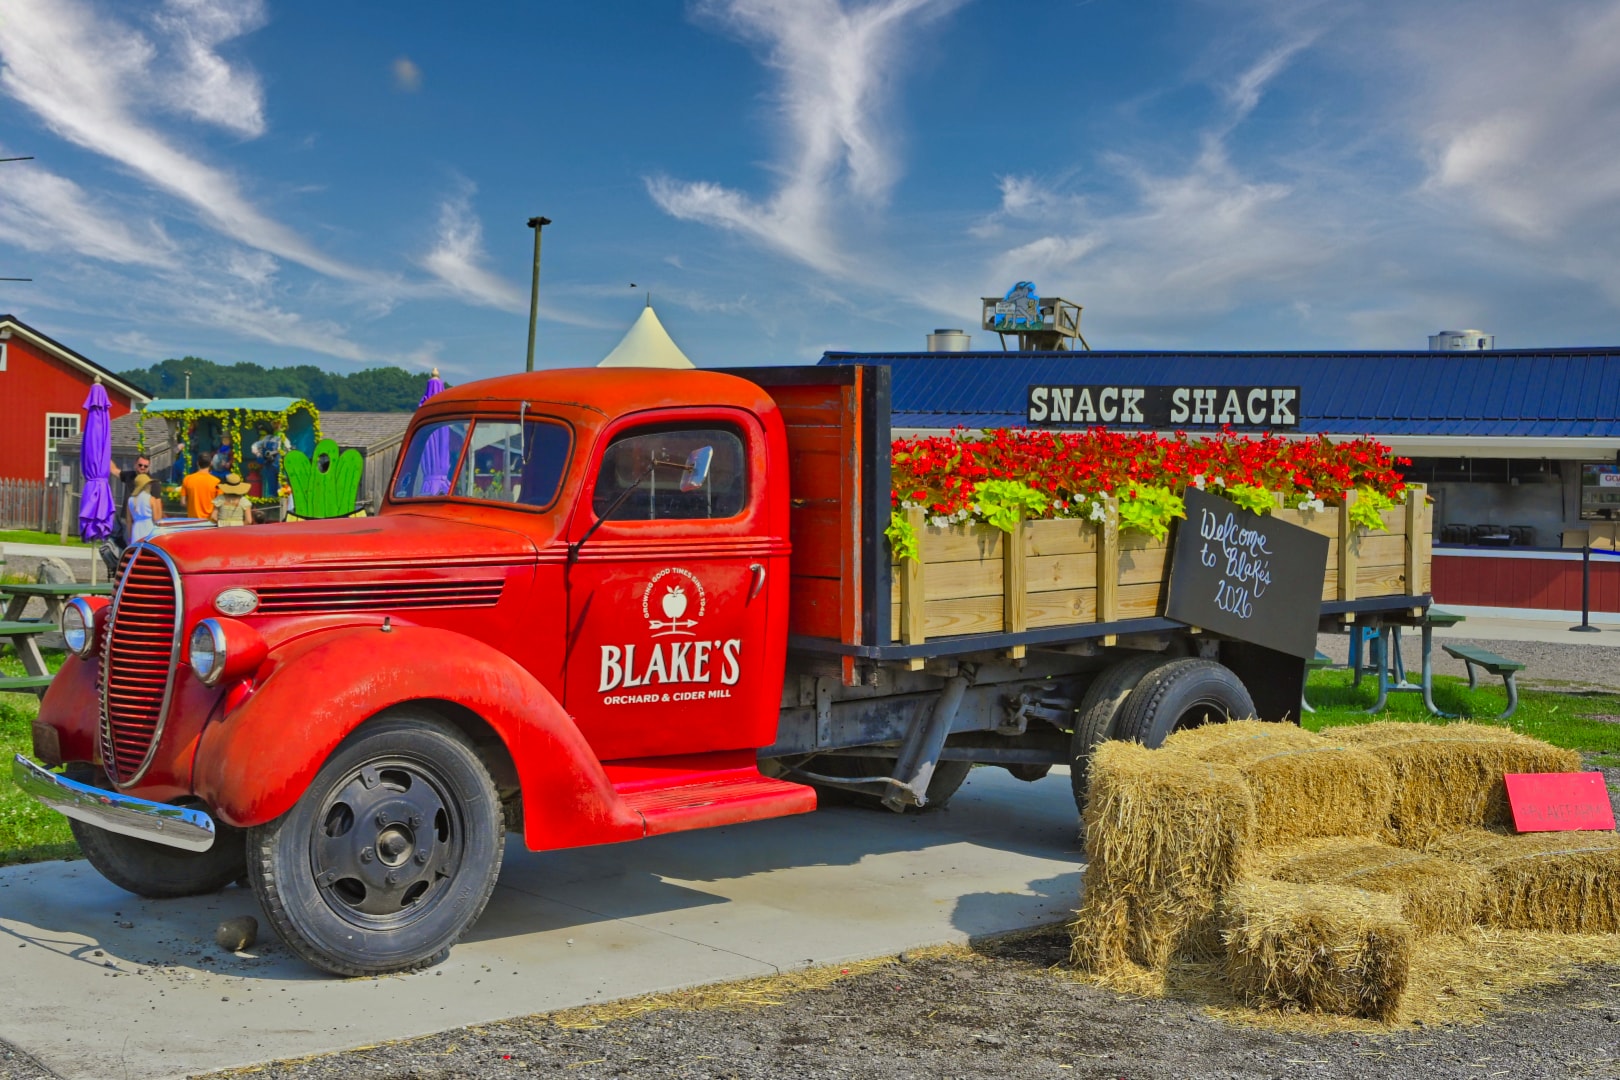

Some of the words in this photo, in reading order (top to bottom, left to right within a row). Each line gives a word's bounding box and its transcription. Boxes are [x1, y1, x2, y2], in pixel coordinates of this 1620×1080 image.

[1030, 387, 1145, 422] SNACK
[1171, 388, 1296, 424] SHACK
[1201, 508, 1272, 557] Welcome
[642, 582, 654, 618] GROWING
[652, 568, 670, 583] GOOD
[672, 567, 692, 578] TIMES
[691, 576, 705, 597] SINCE
[1201, 543, 1216, 567] to
[1226, 547, 1271, 598] Blake's
[1214, 580, 1253, 618] 2026
[598, 638, 741, 693] BLAKE'S
[604, 694, 659, 705] ORCHARD
[661, 694, 670, 702] &
[673, 691, 705, 701] CIDER
[708, 690, 732, 698] MILL
